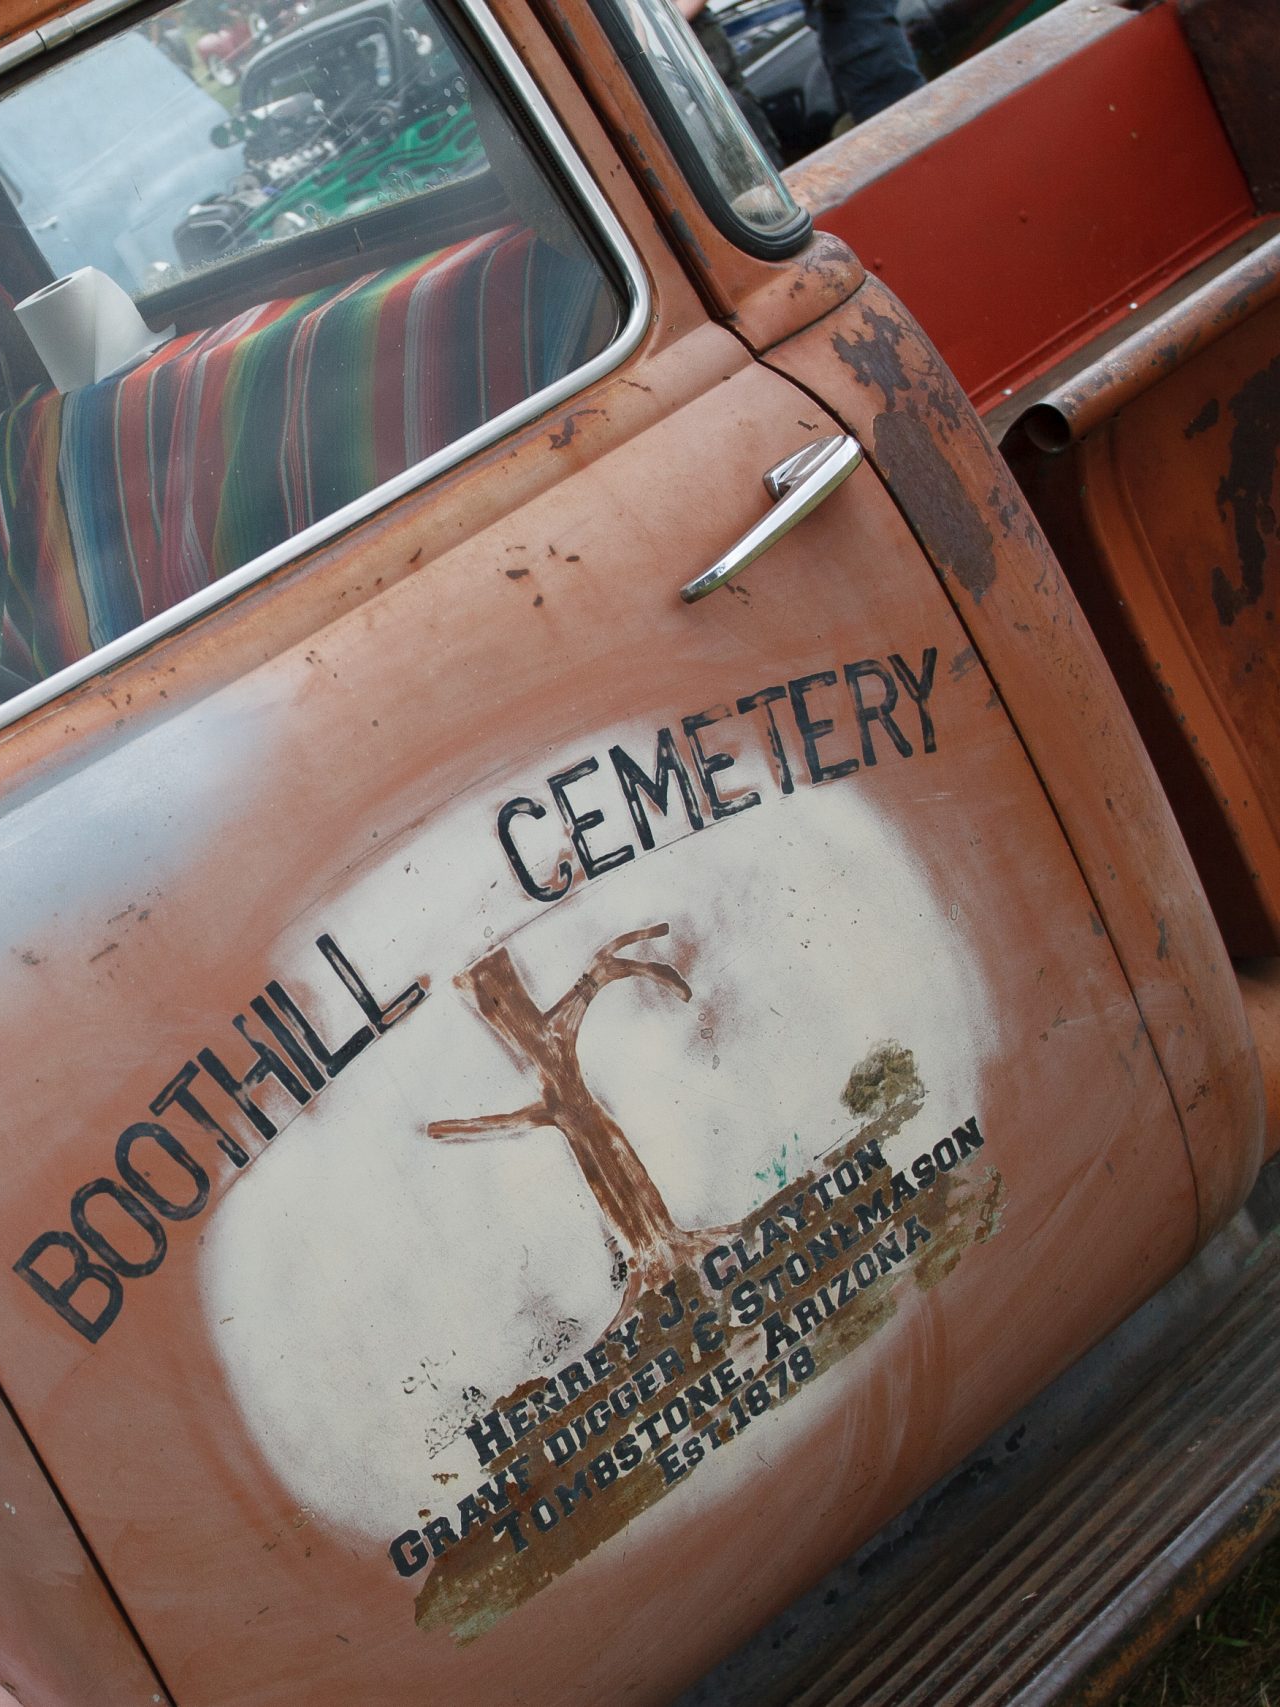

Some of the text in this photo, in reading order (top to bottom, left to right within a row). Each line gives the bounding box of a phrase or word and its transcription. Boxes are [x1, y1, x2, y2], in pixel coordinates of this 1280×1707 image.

[13, 646, 938, 1345] BOOTHILL CEMETERY
[466, 1139, 887, 1466] HENREY J. CLAYTON
[491, 1216, 931, 1553] TOMBSTONE, ARIZONA
[544, 1347, 685, 1467] DIGGER
[692, 1311, 724, 1353] &
